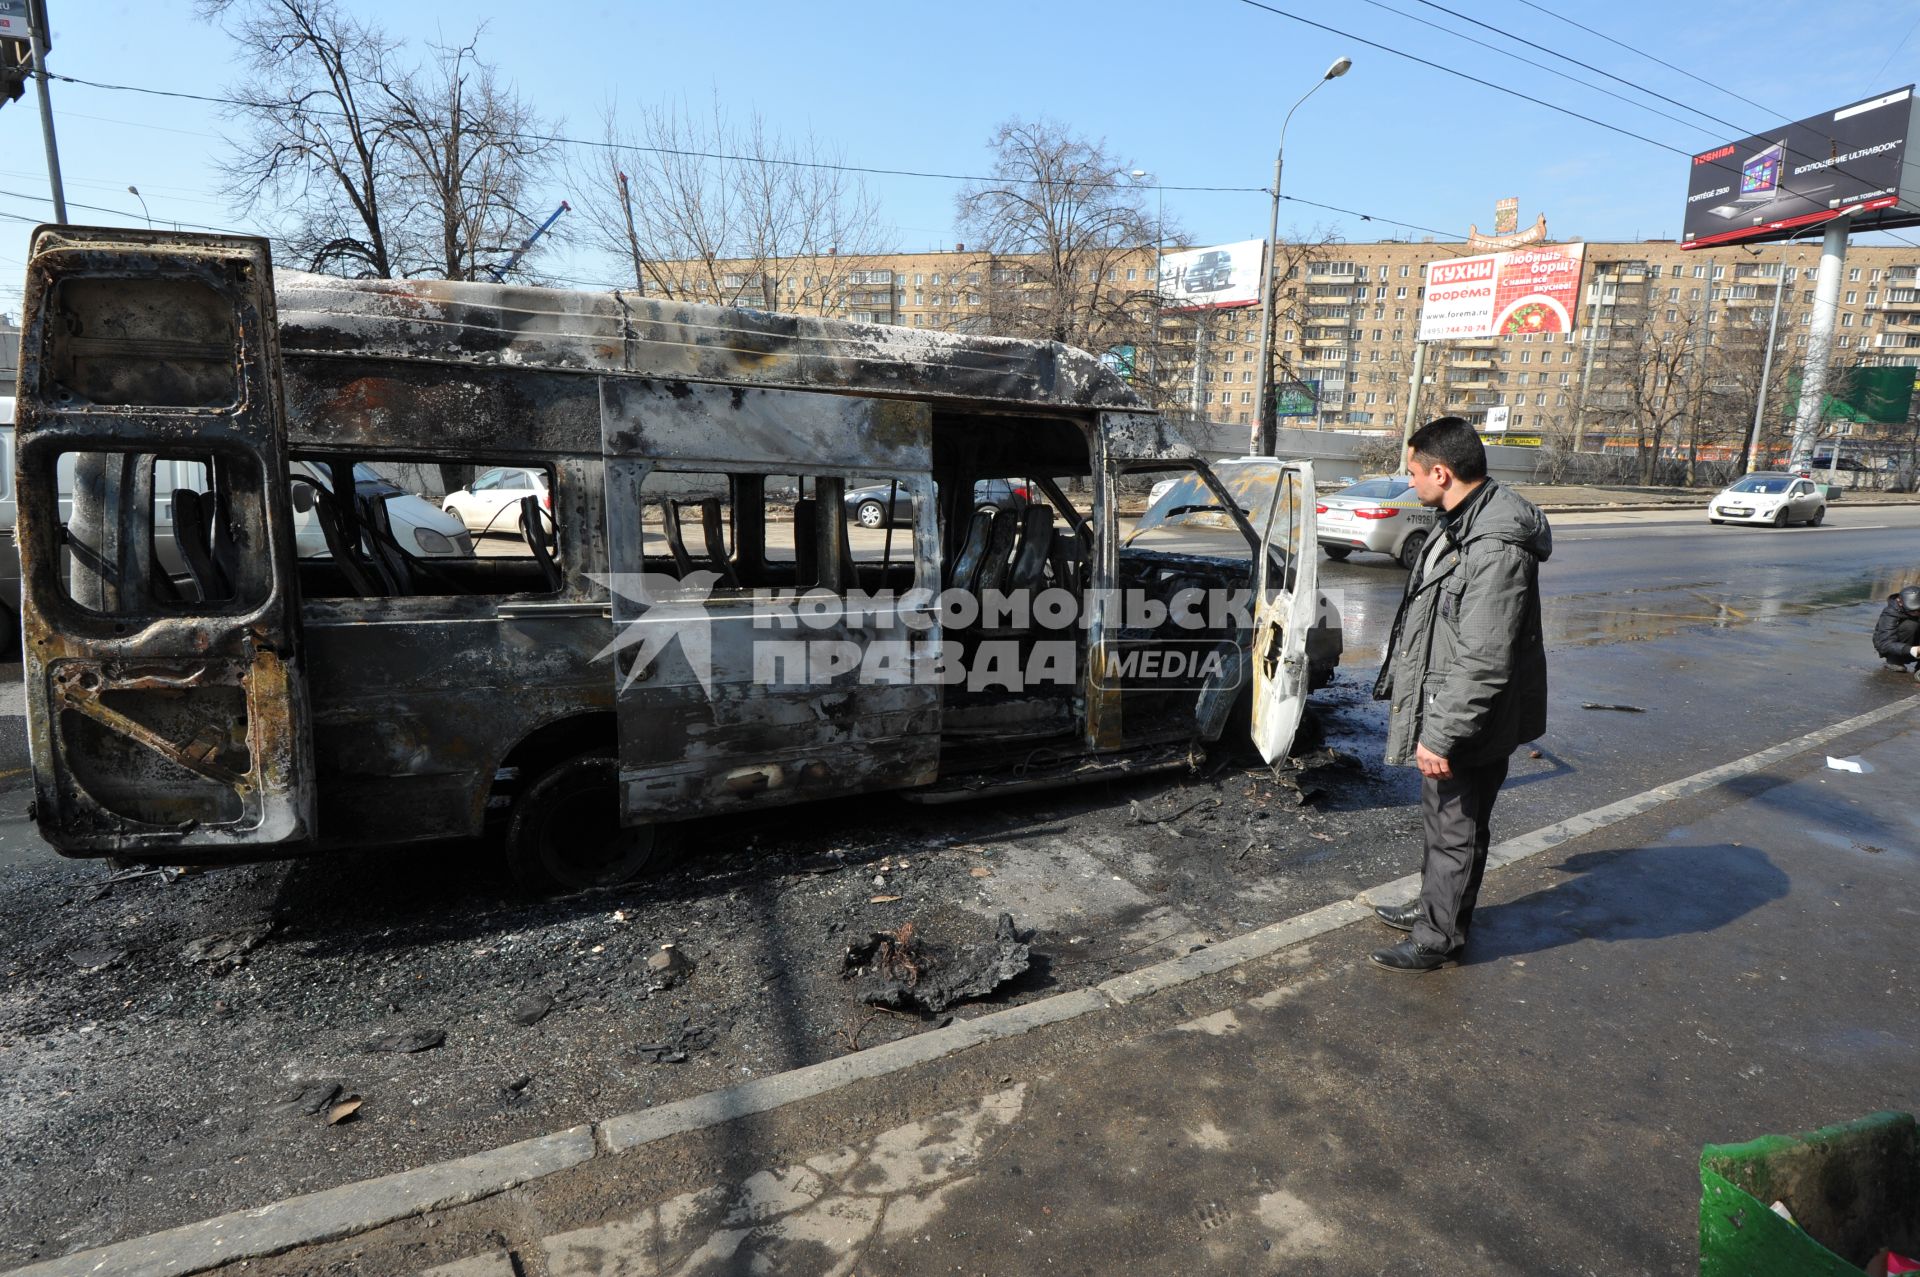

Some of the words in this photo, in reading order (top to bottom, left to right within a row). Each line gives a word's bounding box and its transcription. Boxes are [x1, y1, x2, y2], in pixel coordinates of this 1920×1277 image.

[1694, 145, 1735, 165] TOSHIBA
[1795, 154, 1848, 174] ВОПЛОЩЕНИЕ
[1715, 186, 1730, 196] Z930
[1504, 251, 1561, 266] Любишь
[1432, 261, 1492, 283] КУХНИ
[1531, 259, 1576, 275] борщ?
[1509, 278, 1532, 286] нами
[1534, 281, 1572, 293] вкуснее!
[1426, 309, 1488, 320] www.forema.ru
[1424, 327, 1444, 336] (495)
[1445, 324, 1487, 334] 744-70-74
